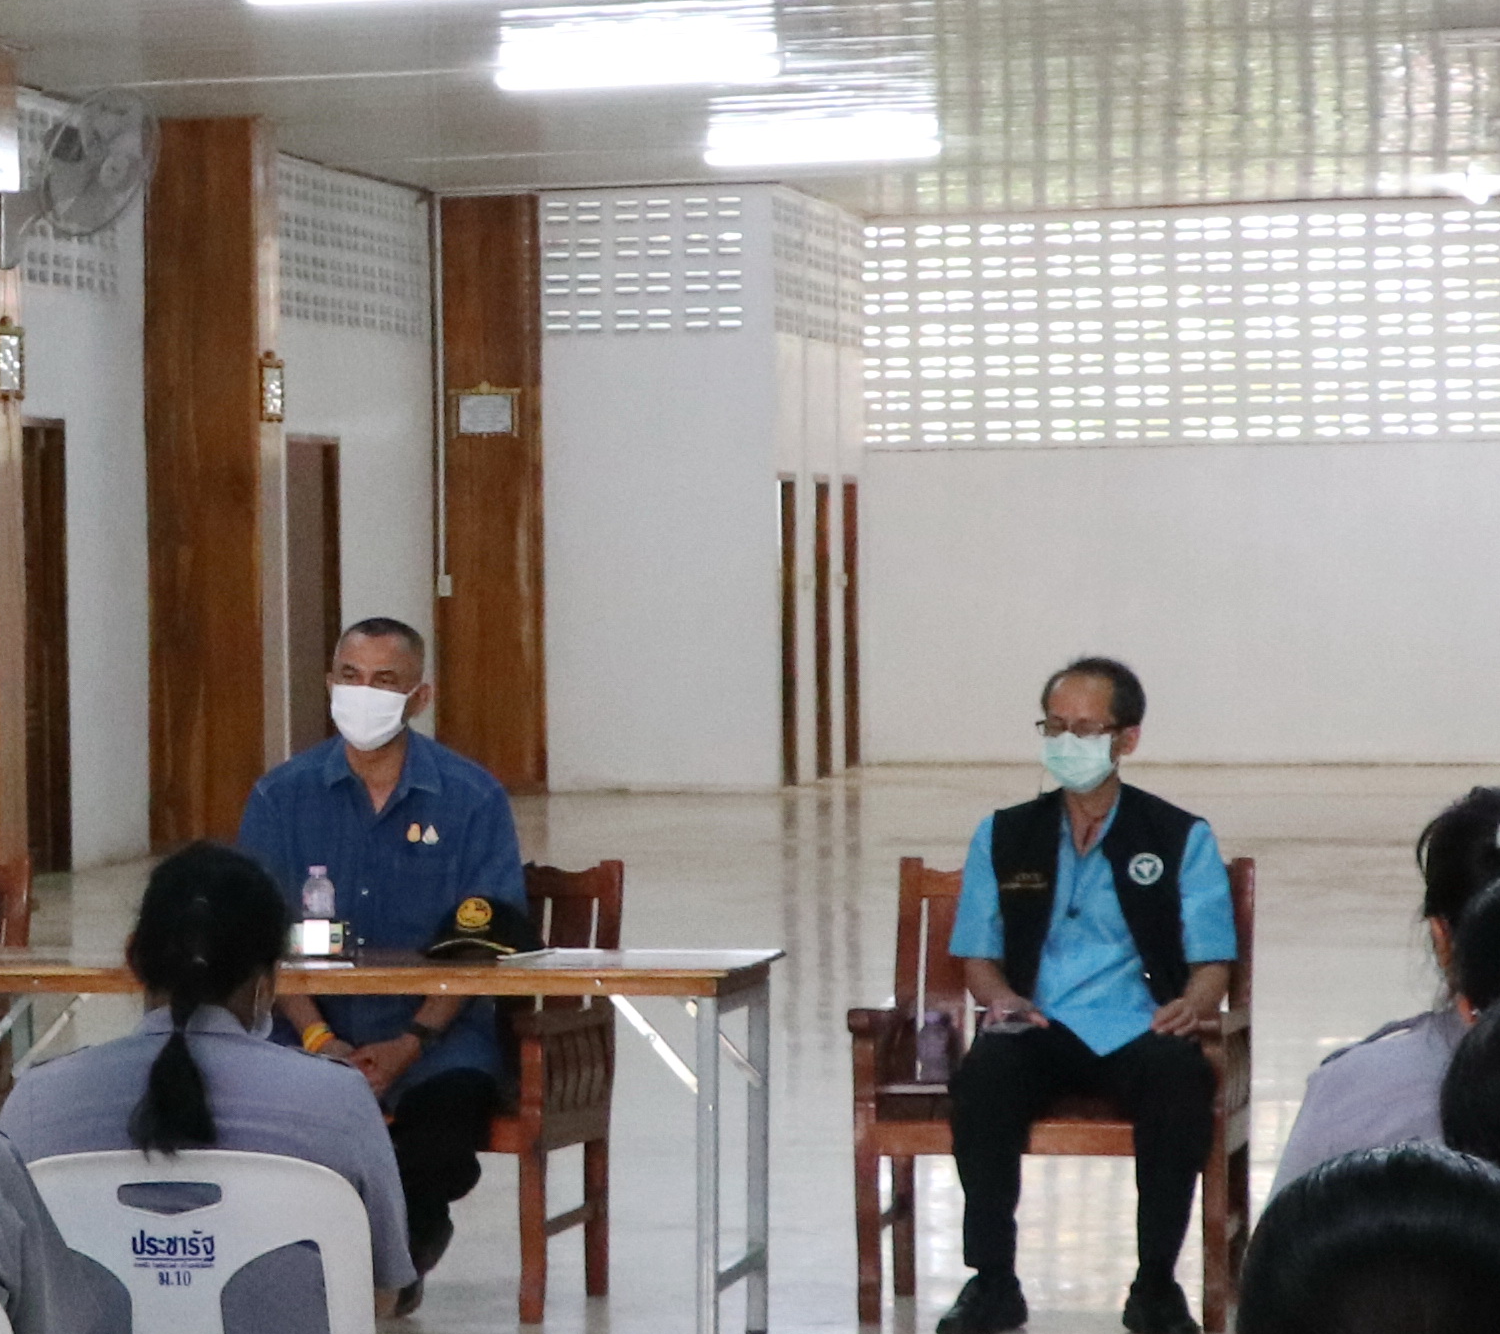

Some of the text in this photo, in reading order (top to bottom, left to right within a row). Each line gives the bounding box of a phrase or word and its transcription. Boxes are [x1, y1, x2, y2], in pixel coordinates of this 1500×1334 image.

[132, 1229, 215, 1261] ประชารัฐ
[158, 1271, 191, 1285] ม.10
